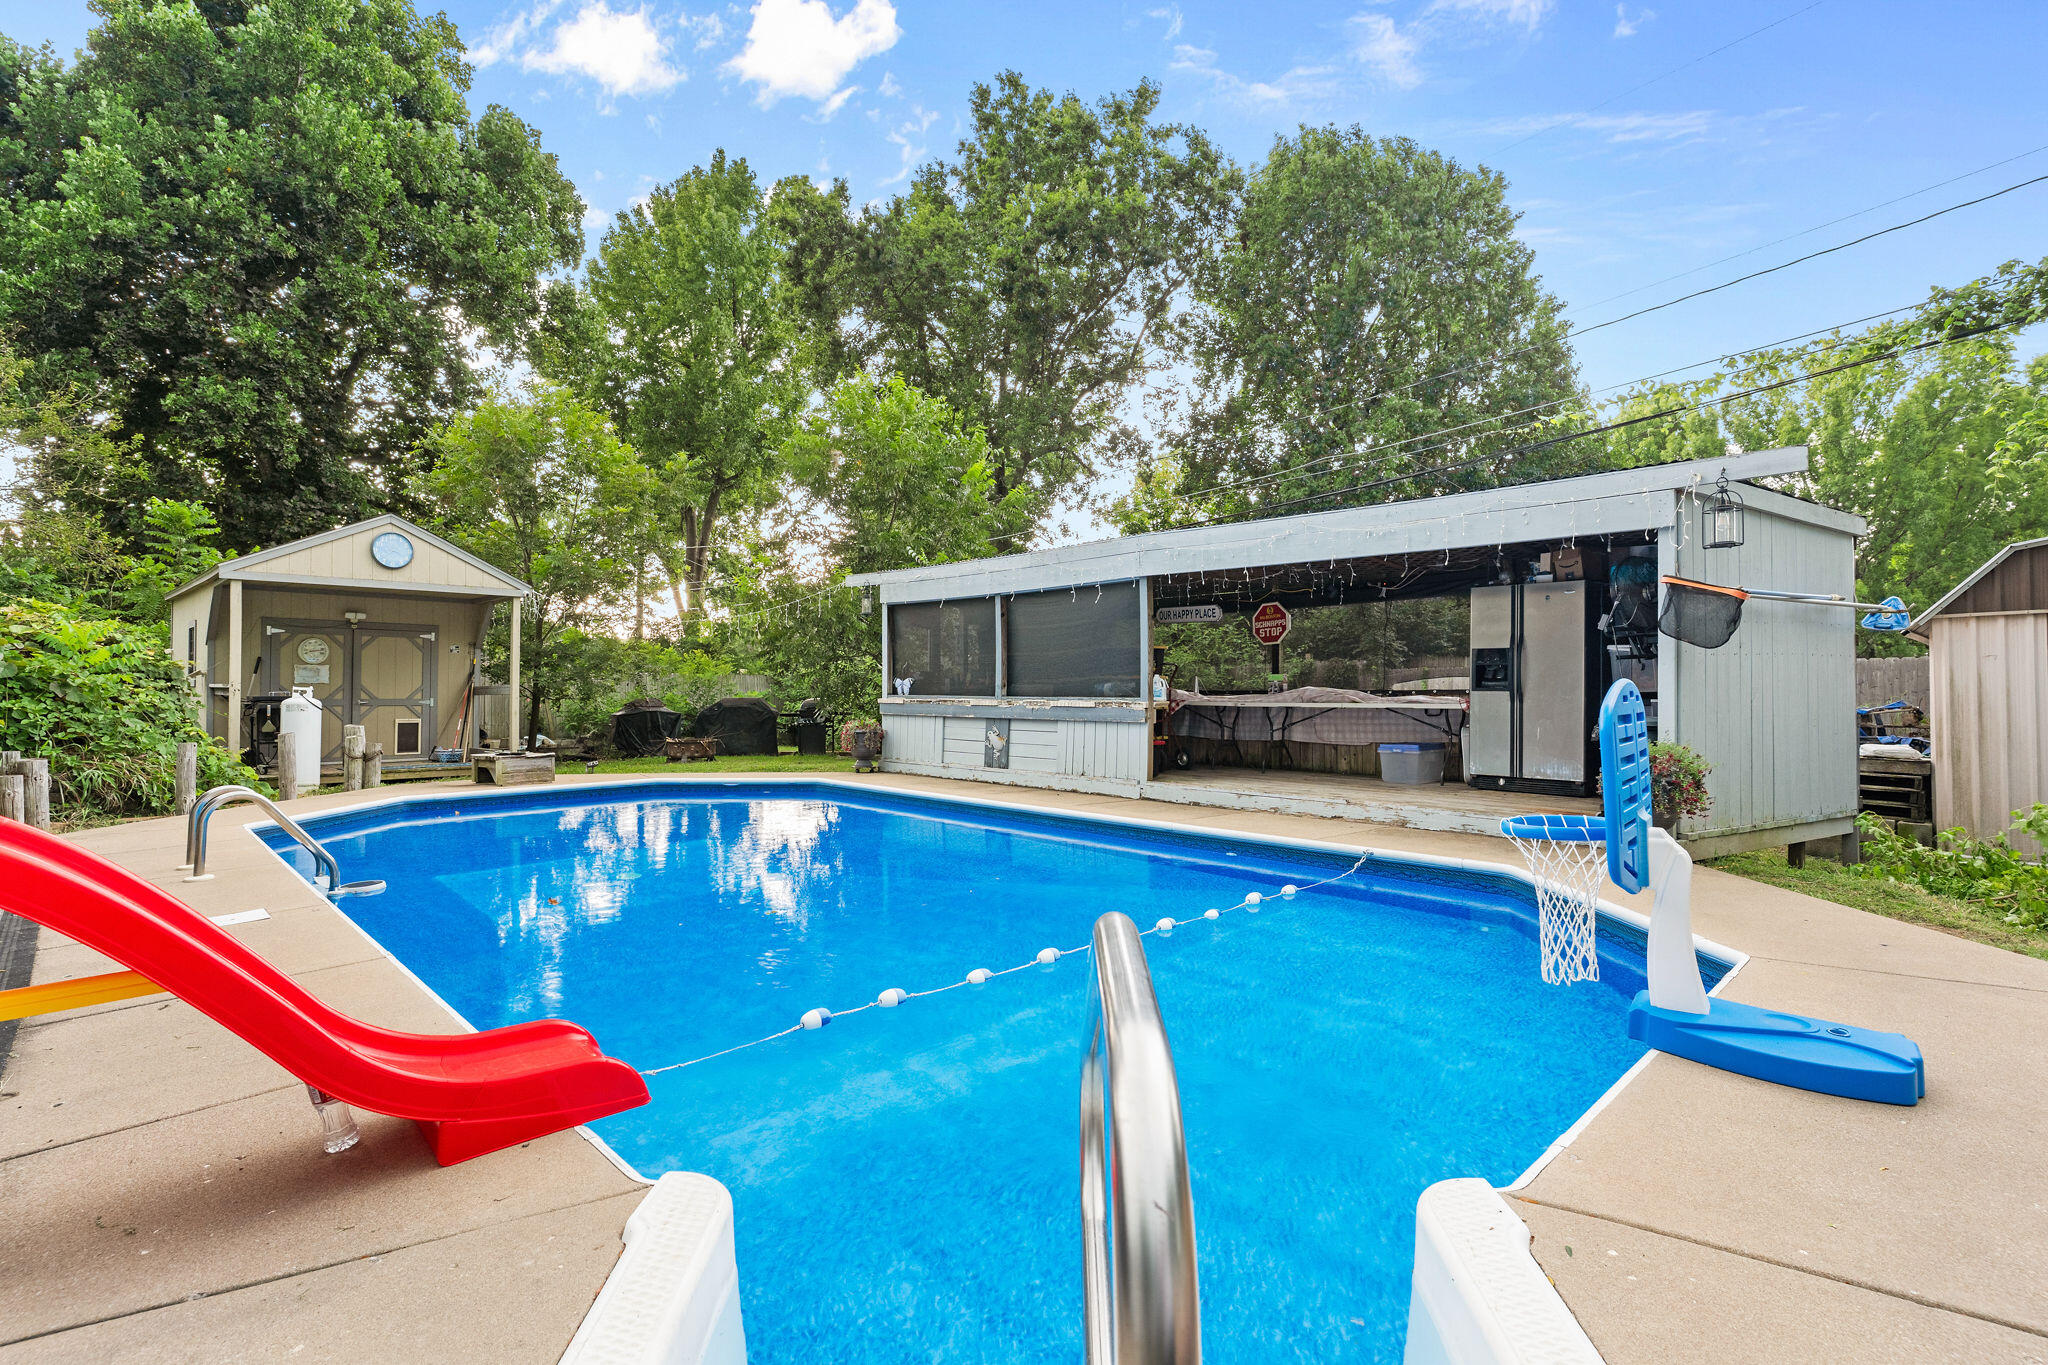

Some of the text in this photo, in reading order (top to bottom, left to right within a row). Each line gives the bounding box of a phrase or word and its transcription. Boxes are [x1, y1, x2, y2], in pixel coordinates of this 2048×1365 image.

[1160, 608, 1216, 620] OUR HAPPY PLACE
[1255, 619, 1286, 628] SCHNAPPS
[1260, 627, 1282, 637] STOP
